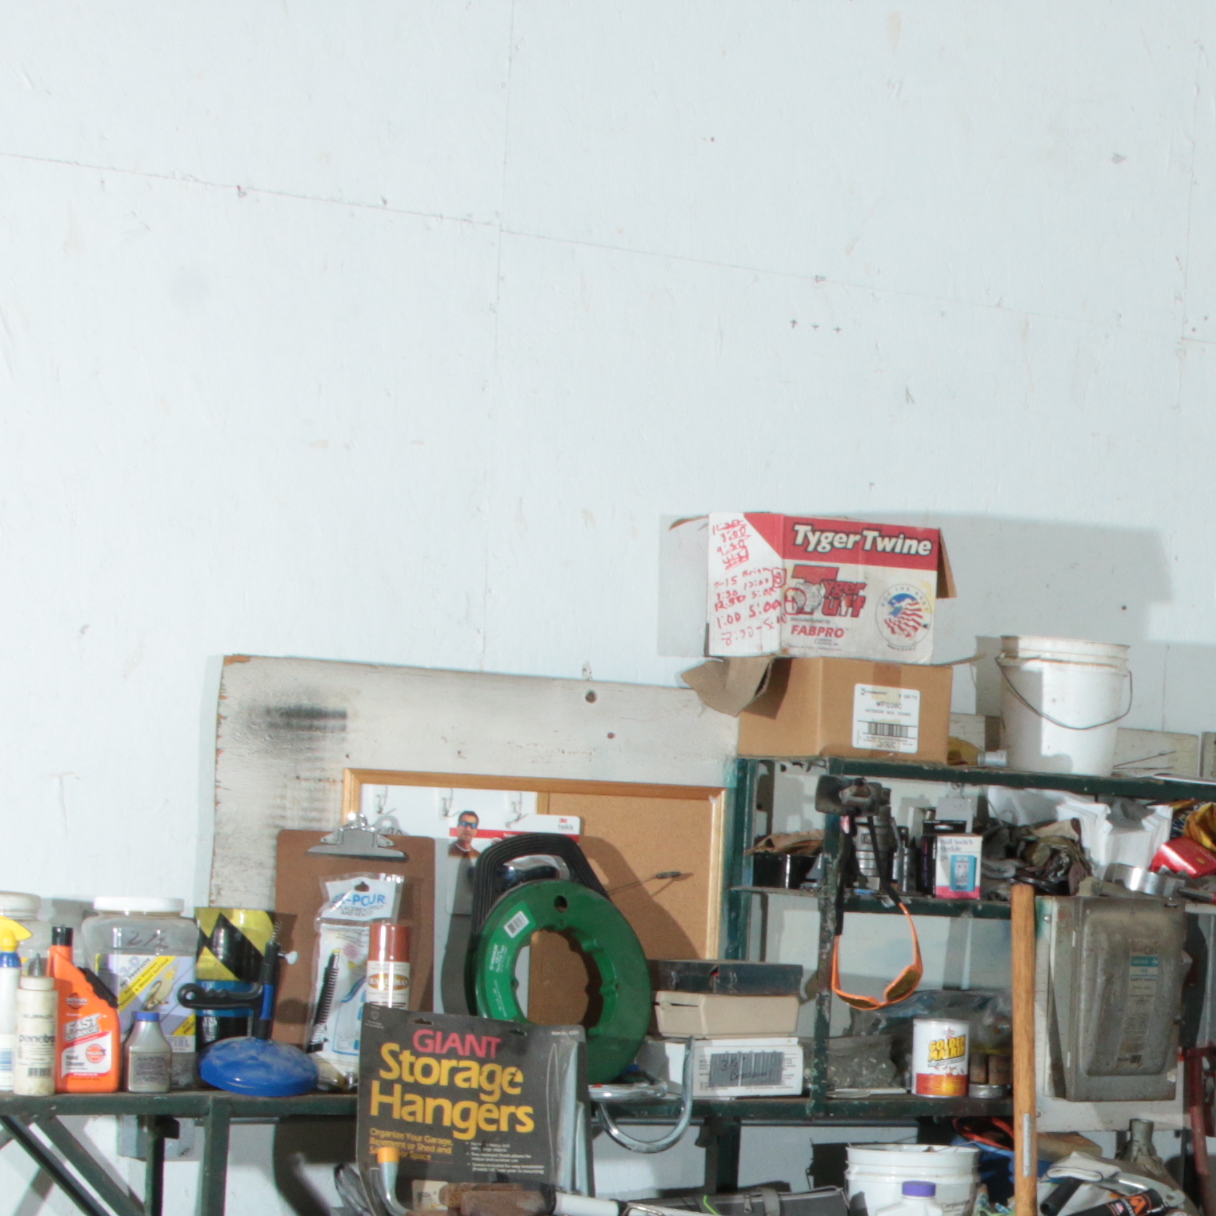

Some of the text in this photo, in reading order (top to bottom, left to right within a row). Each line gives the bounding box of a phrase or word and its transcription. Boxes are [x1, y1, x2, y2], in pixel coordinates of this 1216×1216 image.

[793, 524, 932, 557] Tyger Twine
[790, 624, 845, 639] FABPRO
[413, 1029, 501, 1059] GIANT
[379, 1042, 524, 1102] Storage
[370, 1080, 535, 1140] Hangers
[370, 1127, 405, 1139] Organize
[406, 1132, 423, 1142] Your
